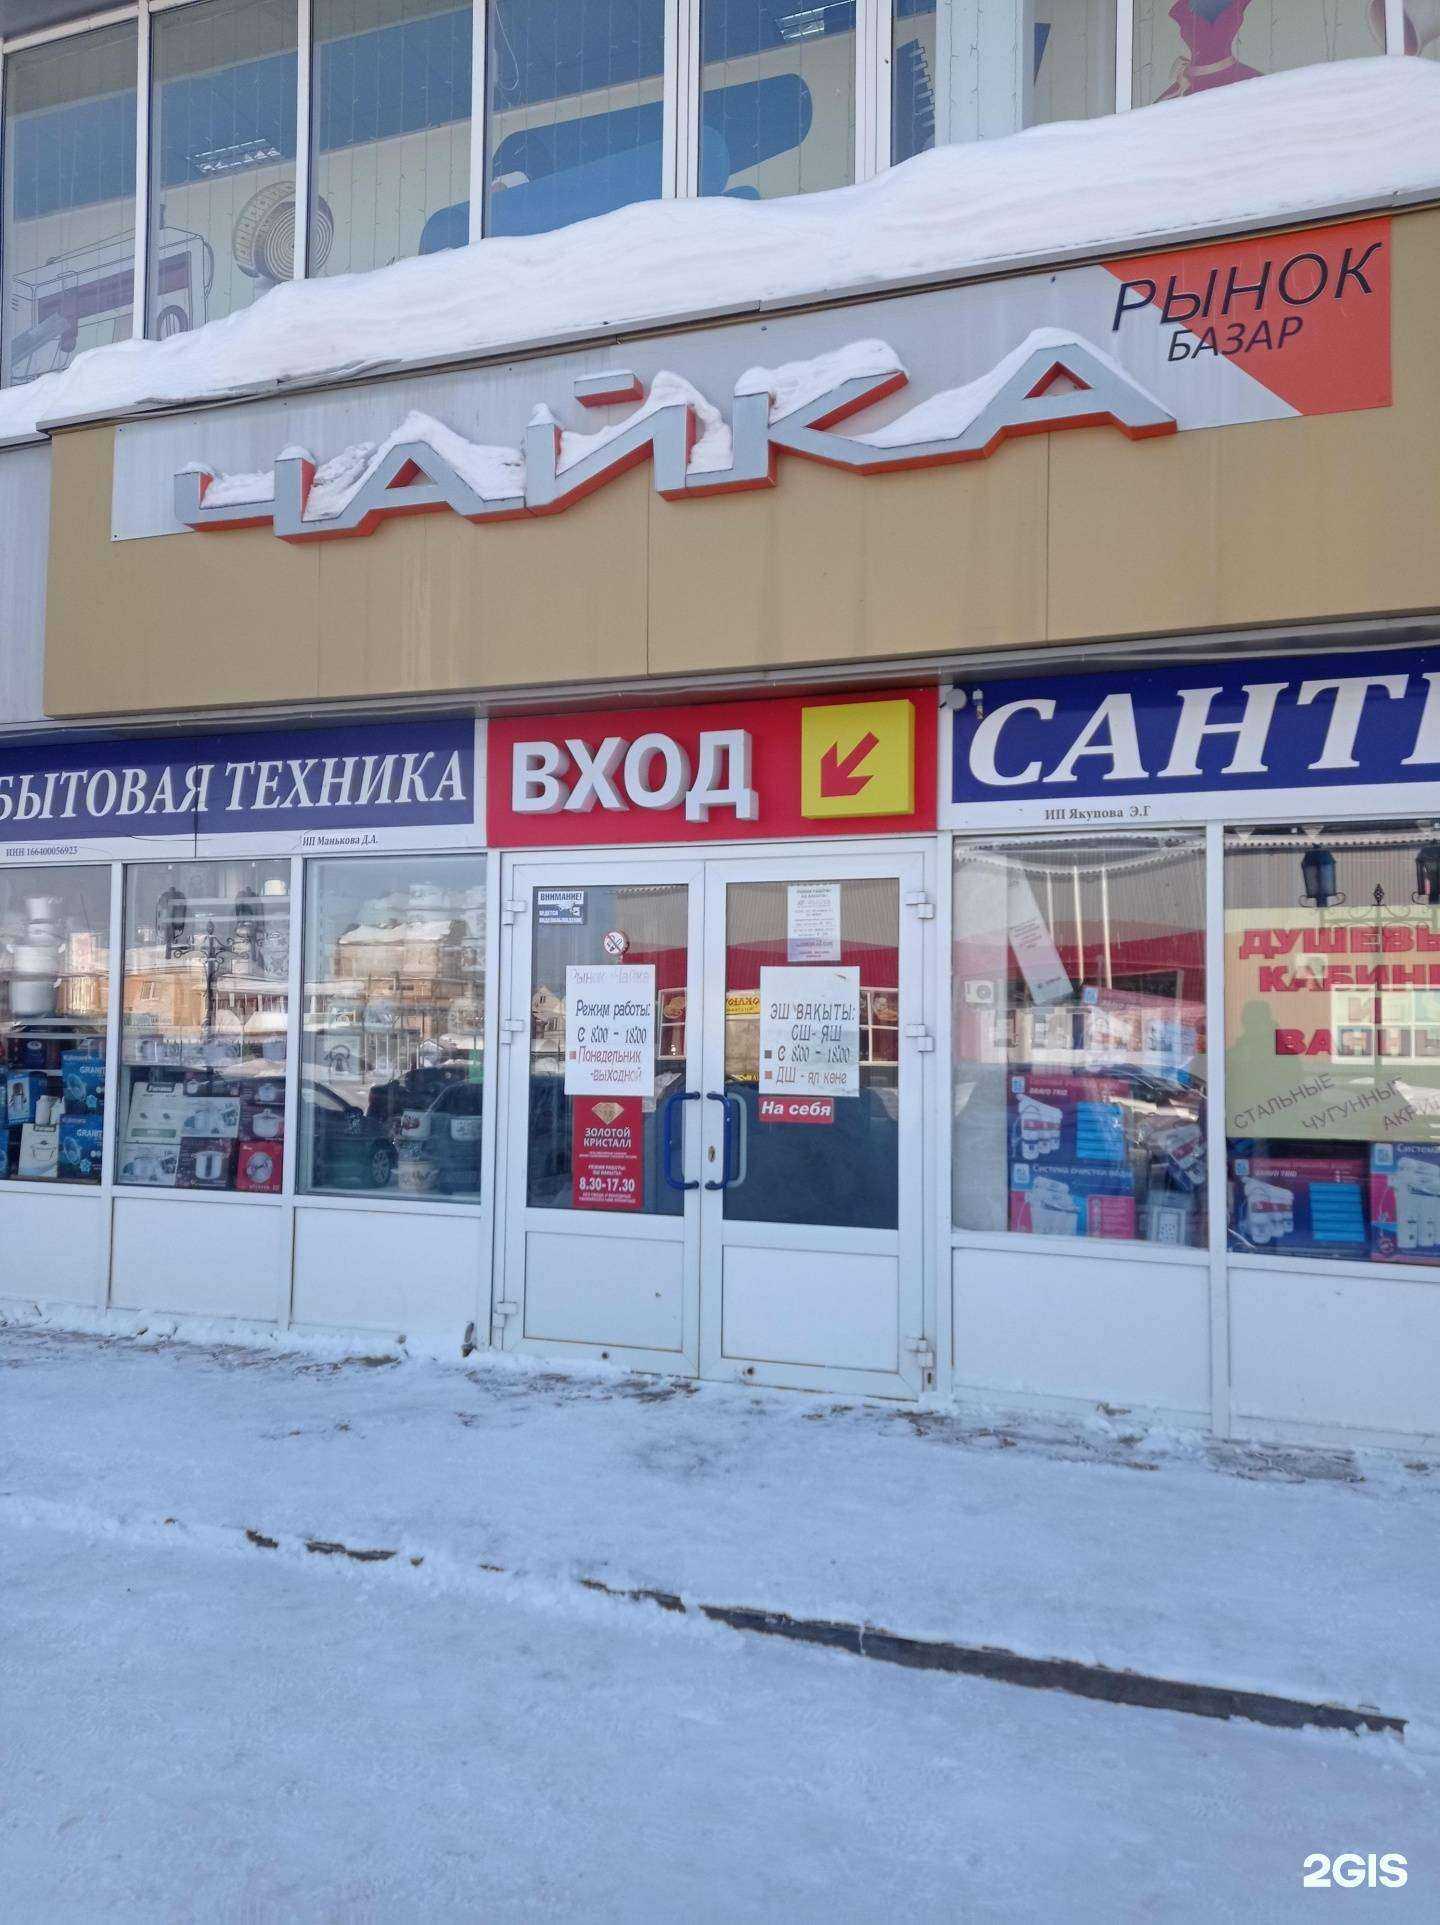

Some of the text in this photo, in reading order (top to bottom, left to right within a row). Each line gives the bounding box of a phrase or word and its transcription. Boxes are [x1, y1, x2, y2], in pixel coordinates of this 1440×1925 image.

[1112, 241, 1384, 333] РЫНОК
[1168, 316, 1304, 362] БАЗАР
[173, 341, 1178, 544] ЧАЙКА
[224, 750, 467, 811] ТЕХНИКА
[511, 728, 759, 823] ВХОД
[1045, 808, 1066, 820] ИП
[1069, 808, 1124, 822] Якупова
[302, 833, 378, 847] ИП Манькова Д.А.
[1259, 963, 1440, 992] КАБИН
[575, 999, 651, 1020] Режим работы:
[578, 1045, 642, 1065] Понедельник
[761, 1100, 831, 1117] На себя
[1233, 1072, 1335, 1130] СТАЛЬНЫЕ
[584, 1126, 631, 1138] ЗОЛОТОЙ
[583, 1137, 632, 1149] КРИСТАЛЛ
[579, 1176, 636, 1193] 8.30-17.30
